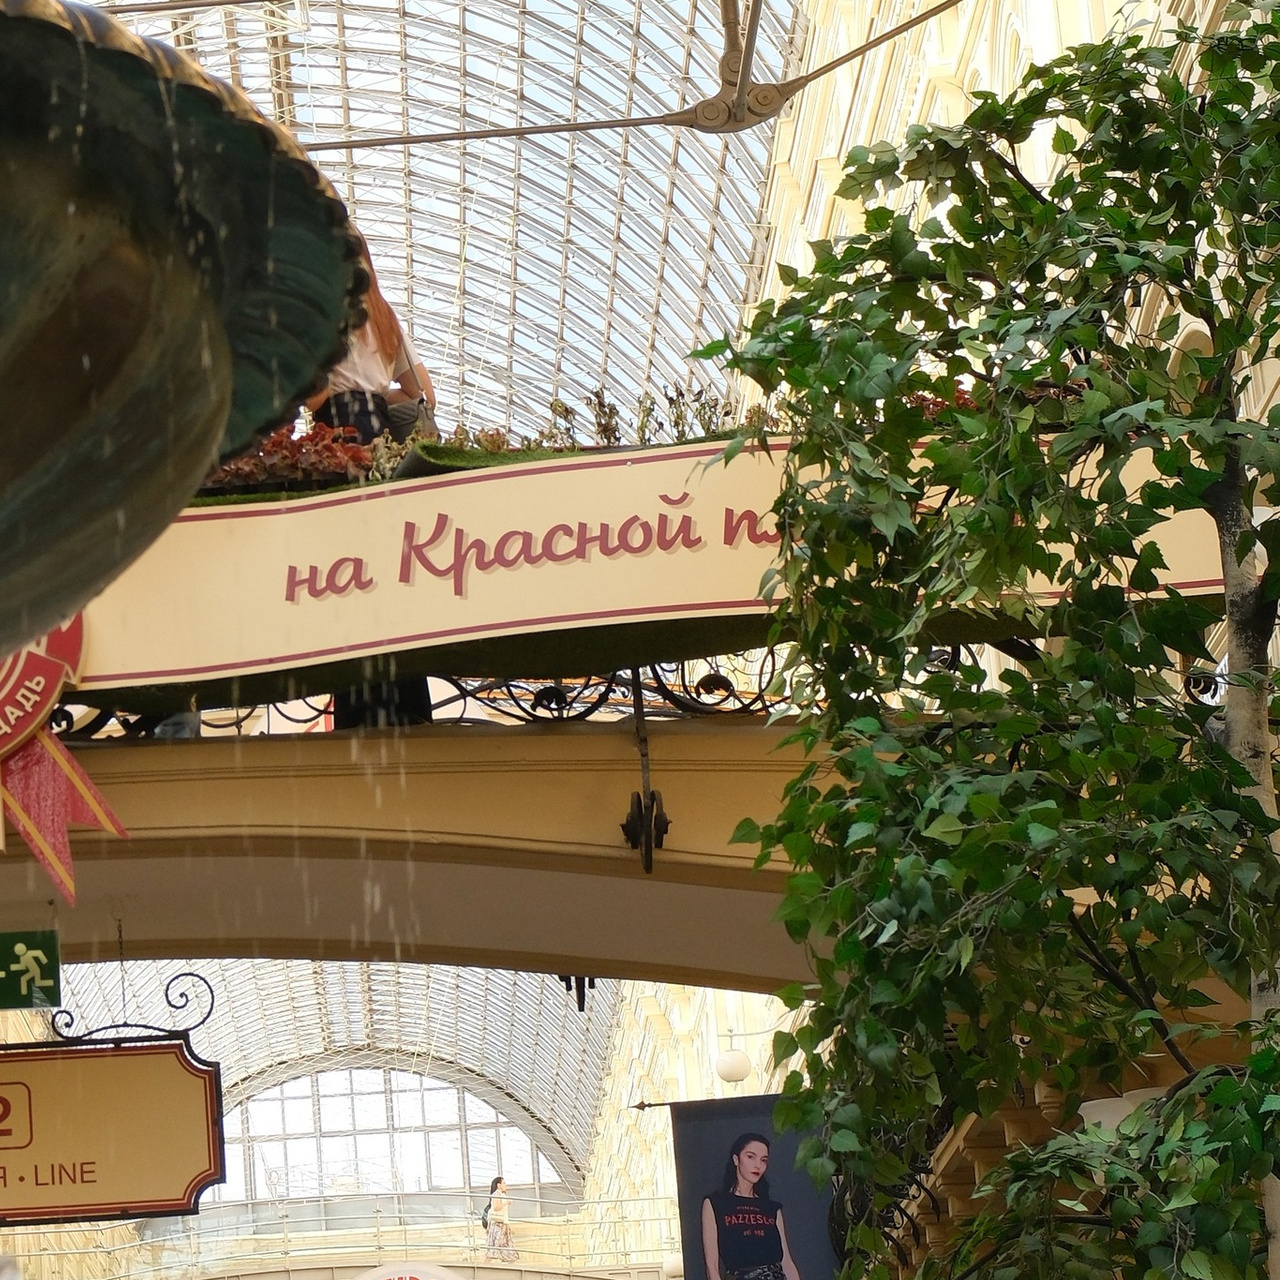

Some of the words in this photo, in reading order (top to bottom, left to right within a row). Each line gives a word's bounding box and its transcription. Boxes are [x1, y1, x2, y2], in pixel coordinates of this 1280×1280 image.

[285, 556, 374, 602] на
[399, 491, 703, 596] Красной
[33, 1161, 98, 1187] LINE
